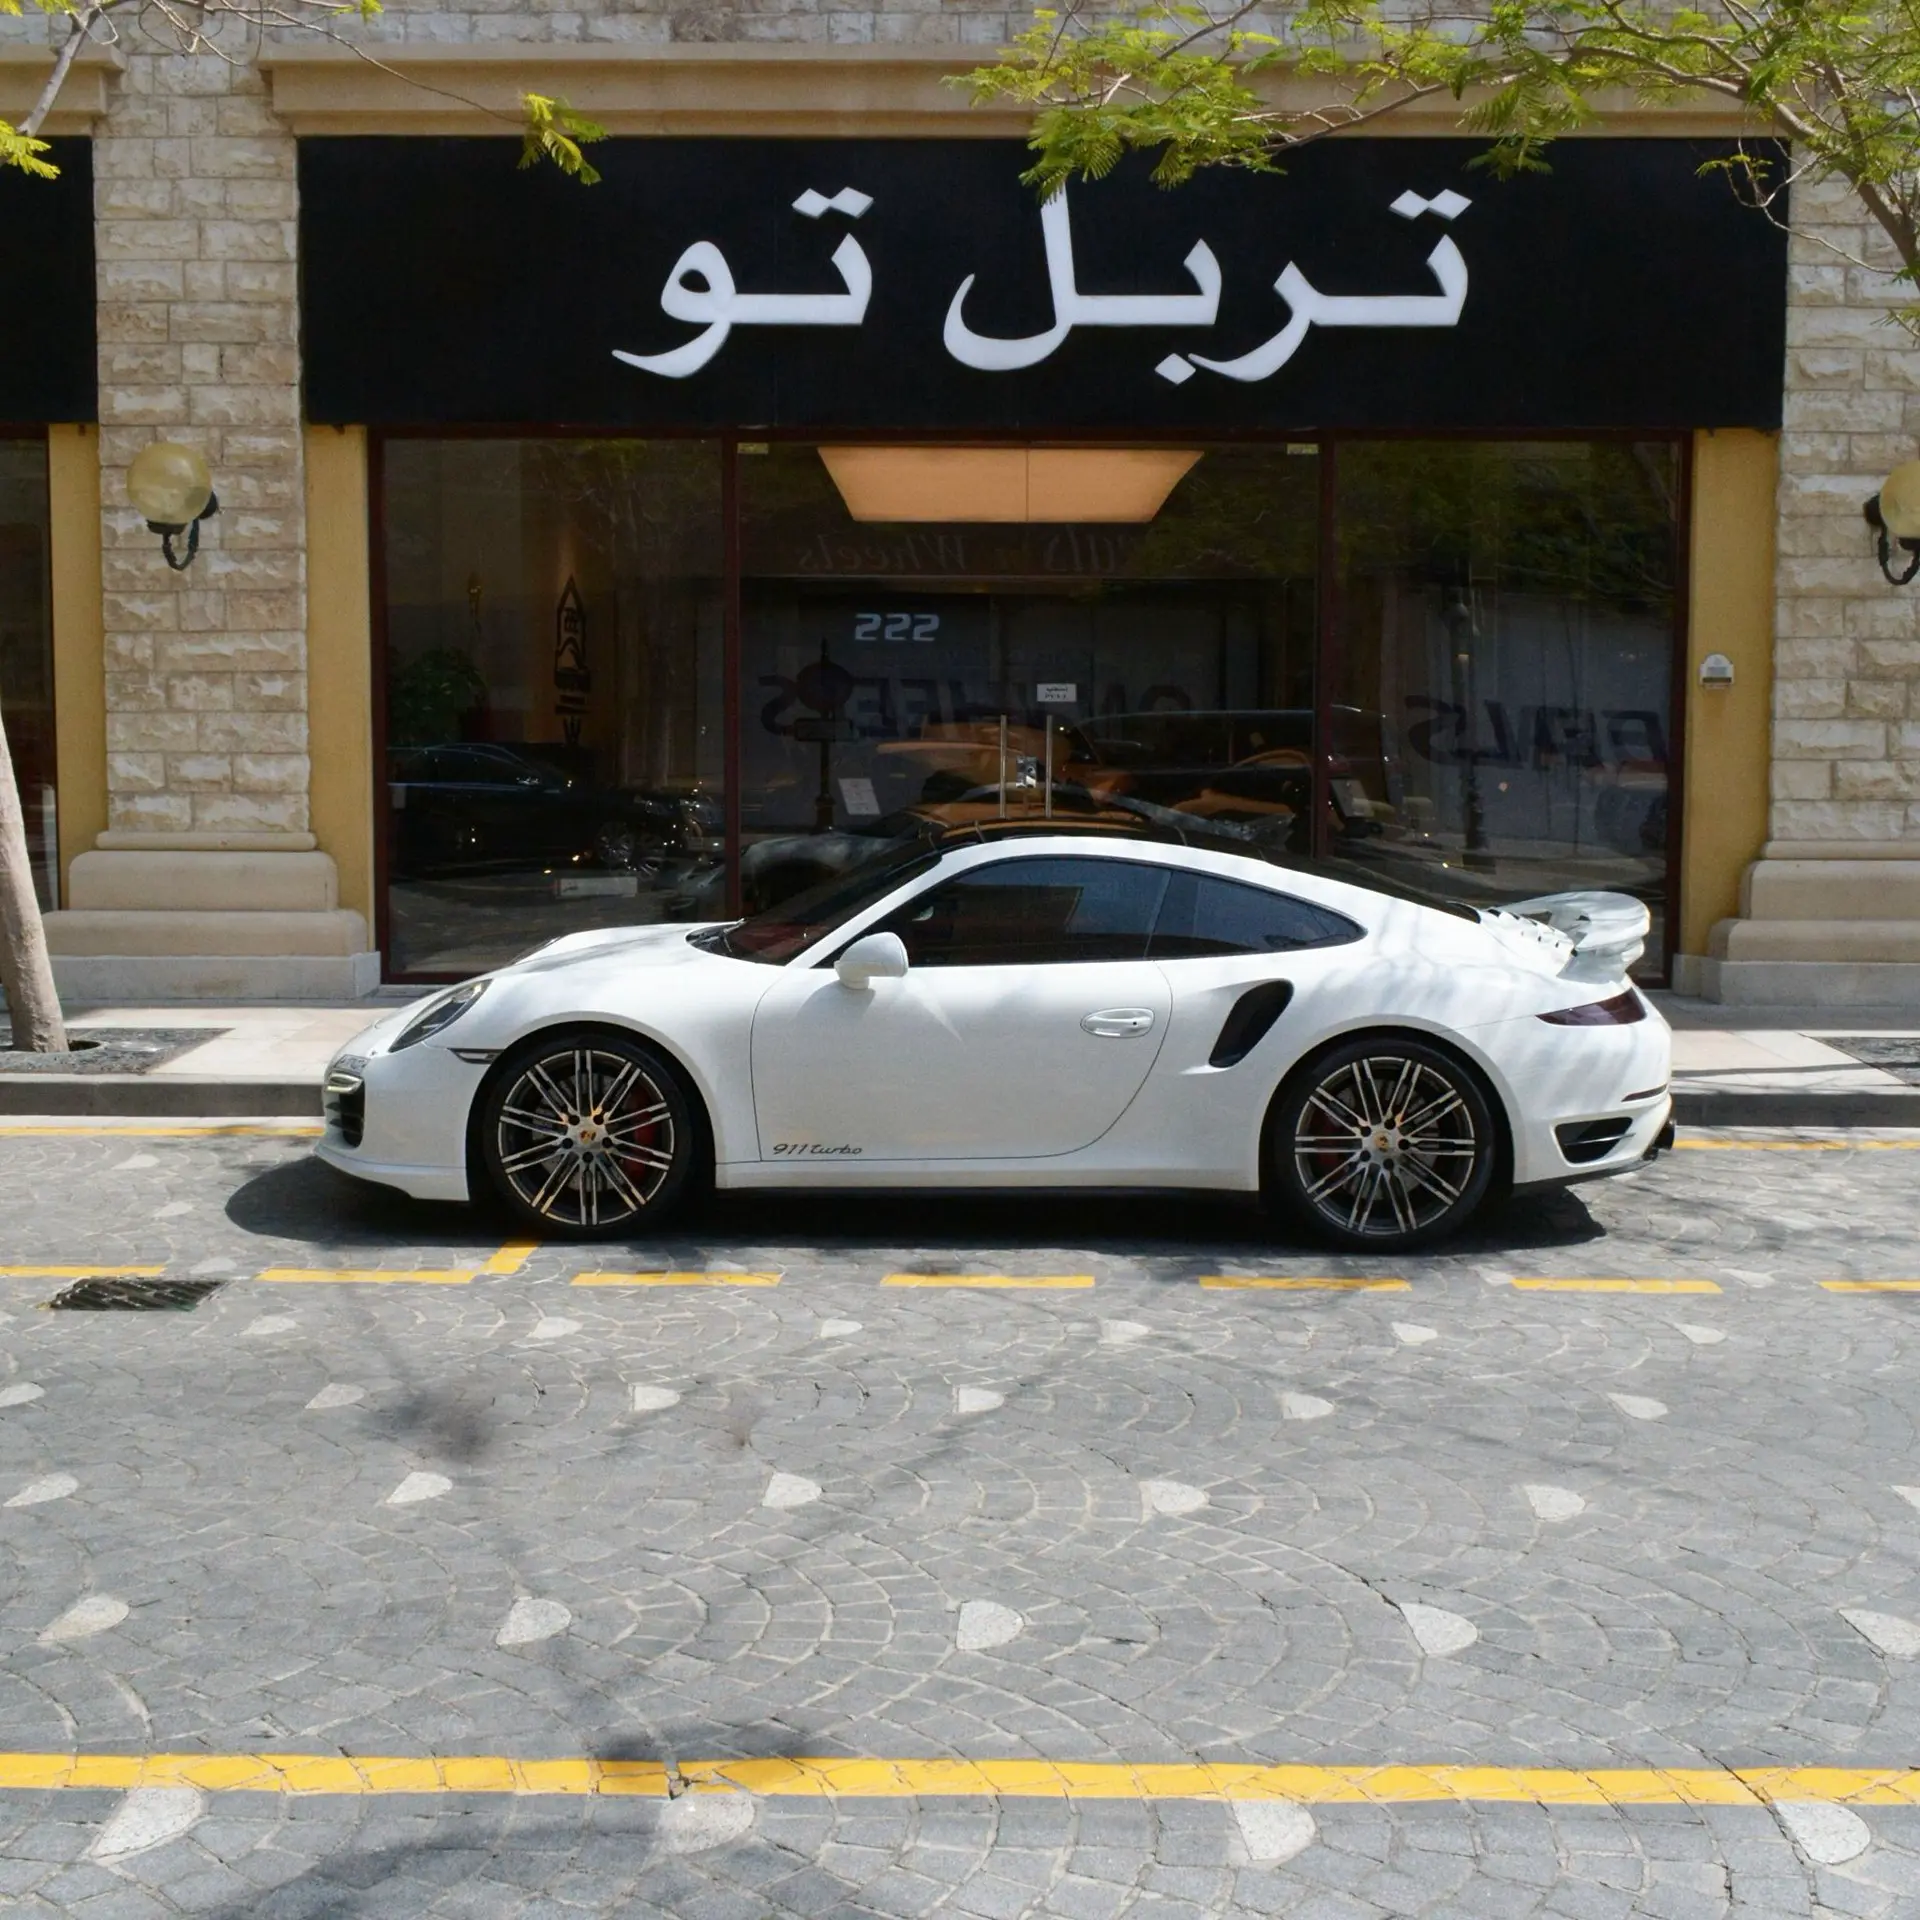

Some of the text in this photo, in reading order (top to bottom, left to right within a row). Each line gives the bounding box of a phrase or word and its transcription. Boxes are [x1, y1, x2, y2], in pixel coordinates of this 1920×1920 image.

[612, 180, 1473, 386] تربل تو
[854, 612, 940, 641] 222
[773, 1143, 863, 1155] 911 turbo
